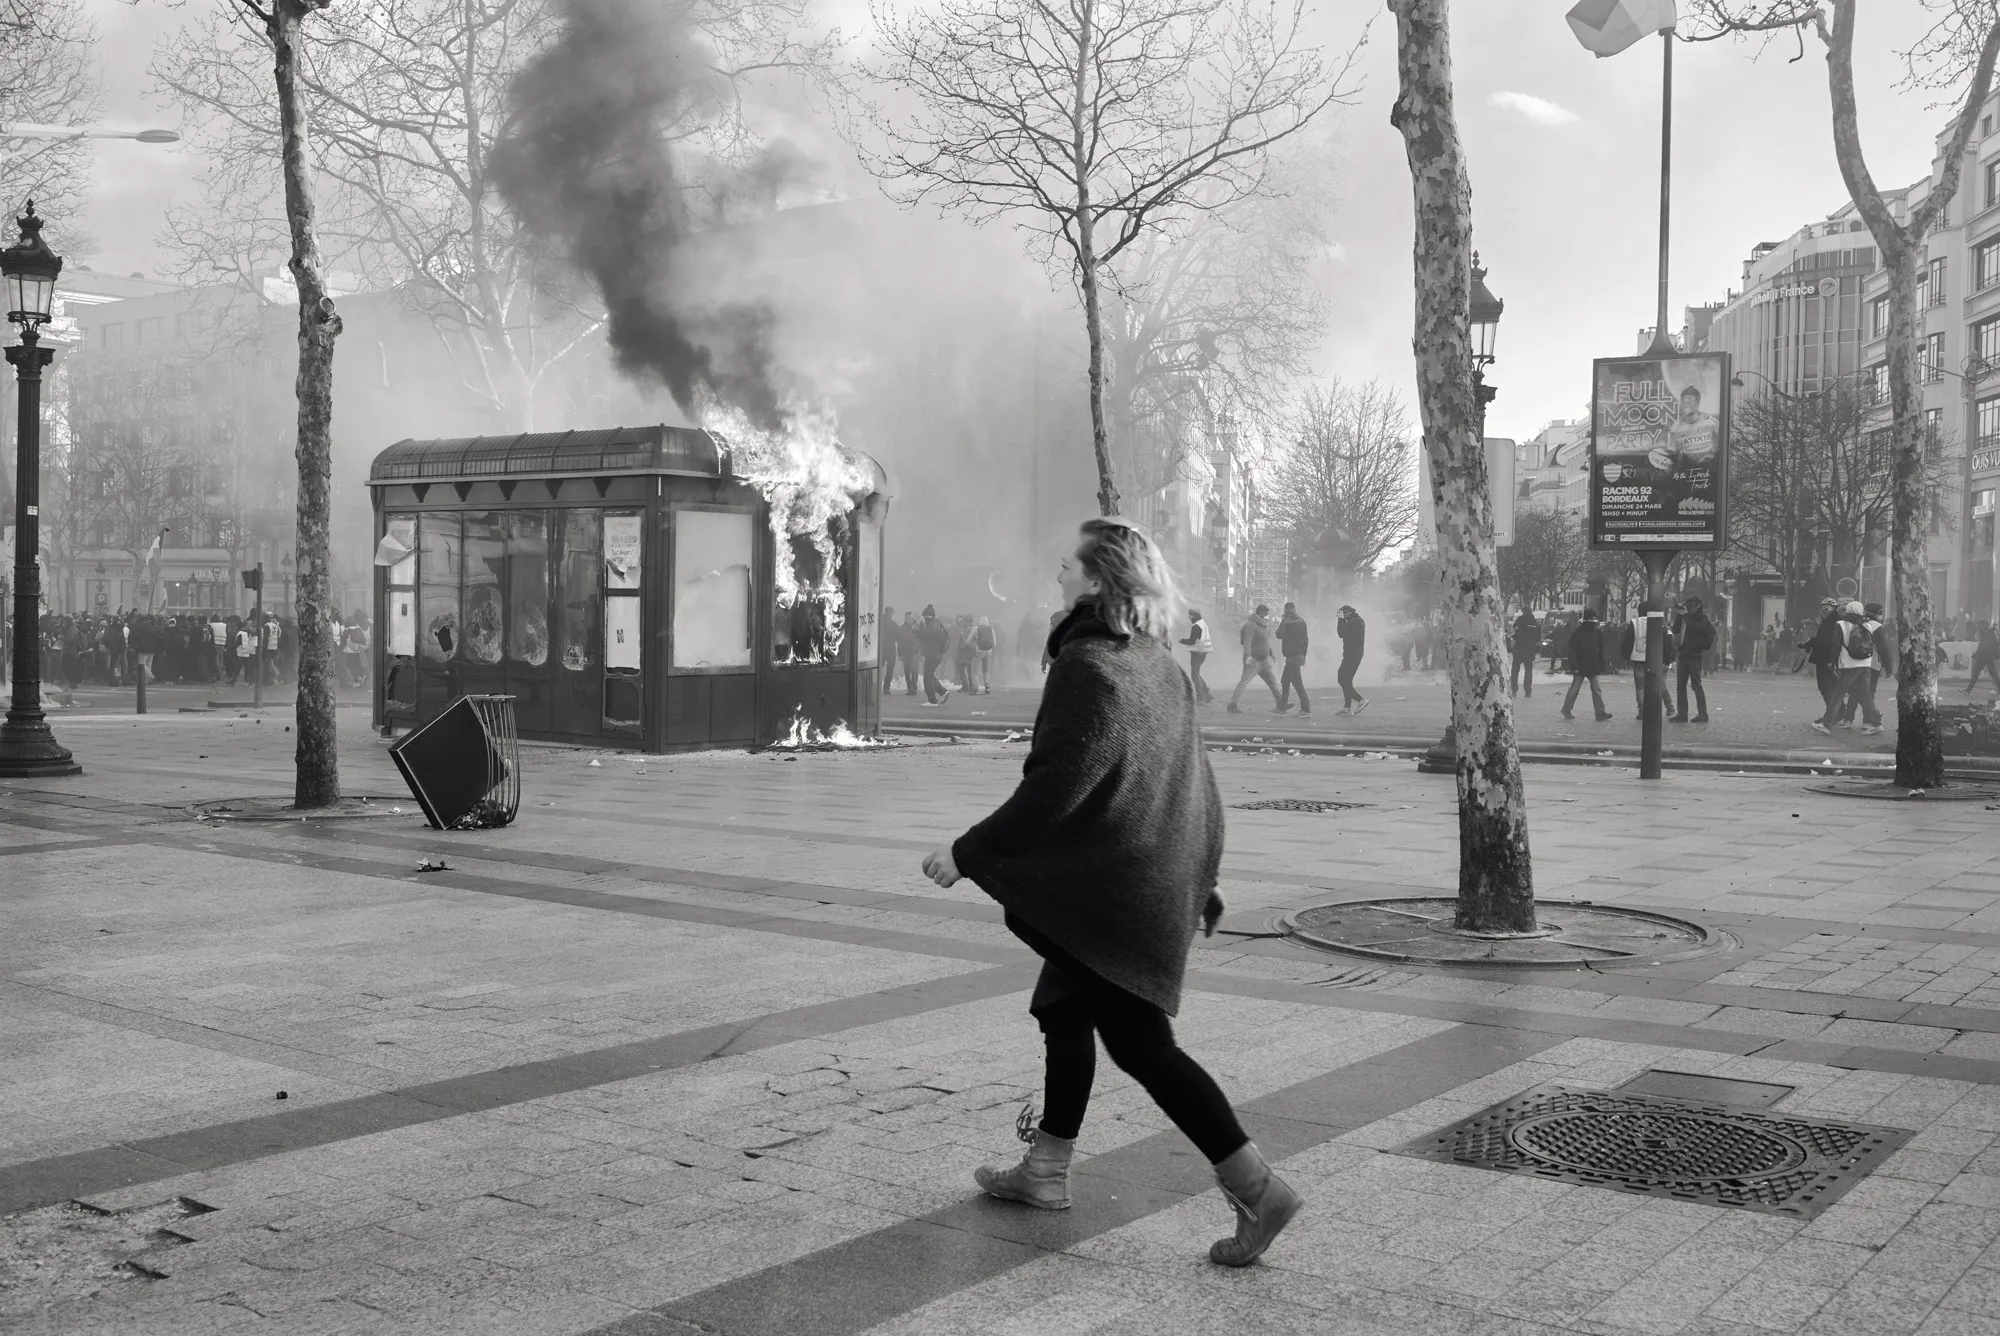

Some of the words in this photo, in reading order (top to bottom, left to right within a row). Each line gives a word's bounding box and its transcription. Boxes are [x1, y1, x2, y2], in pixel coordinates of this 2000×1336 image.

[1780, 285, 1815, 298] France
[1615, 380, 1673, 404] FULL
[1603, 401, 1680, 427] MOON
[1605, 428, 1662, 450] PARTY
[1602, 486, 1639, 496] RACING
[1640, 486, 1652, 495] 92
[1602, 495, 1649, 503] BORDEAUX
